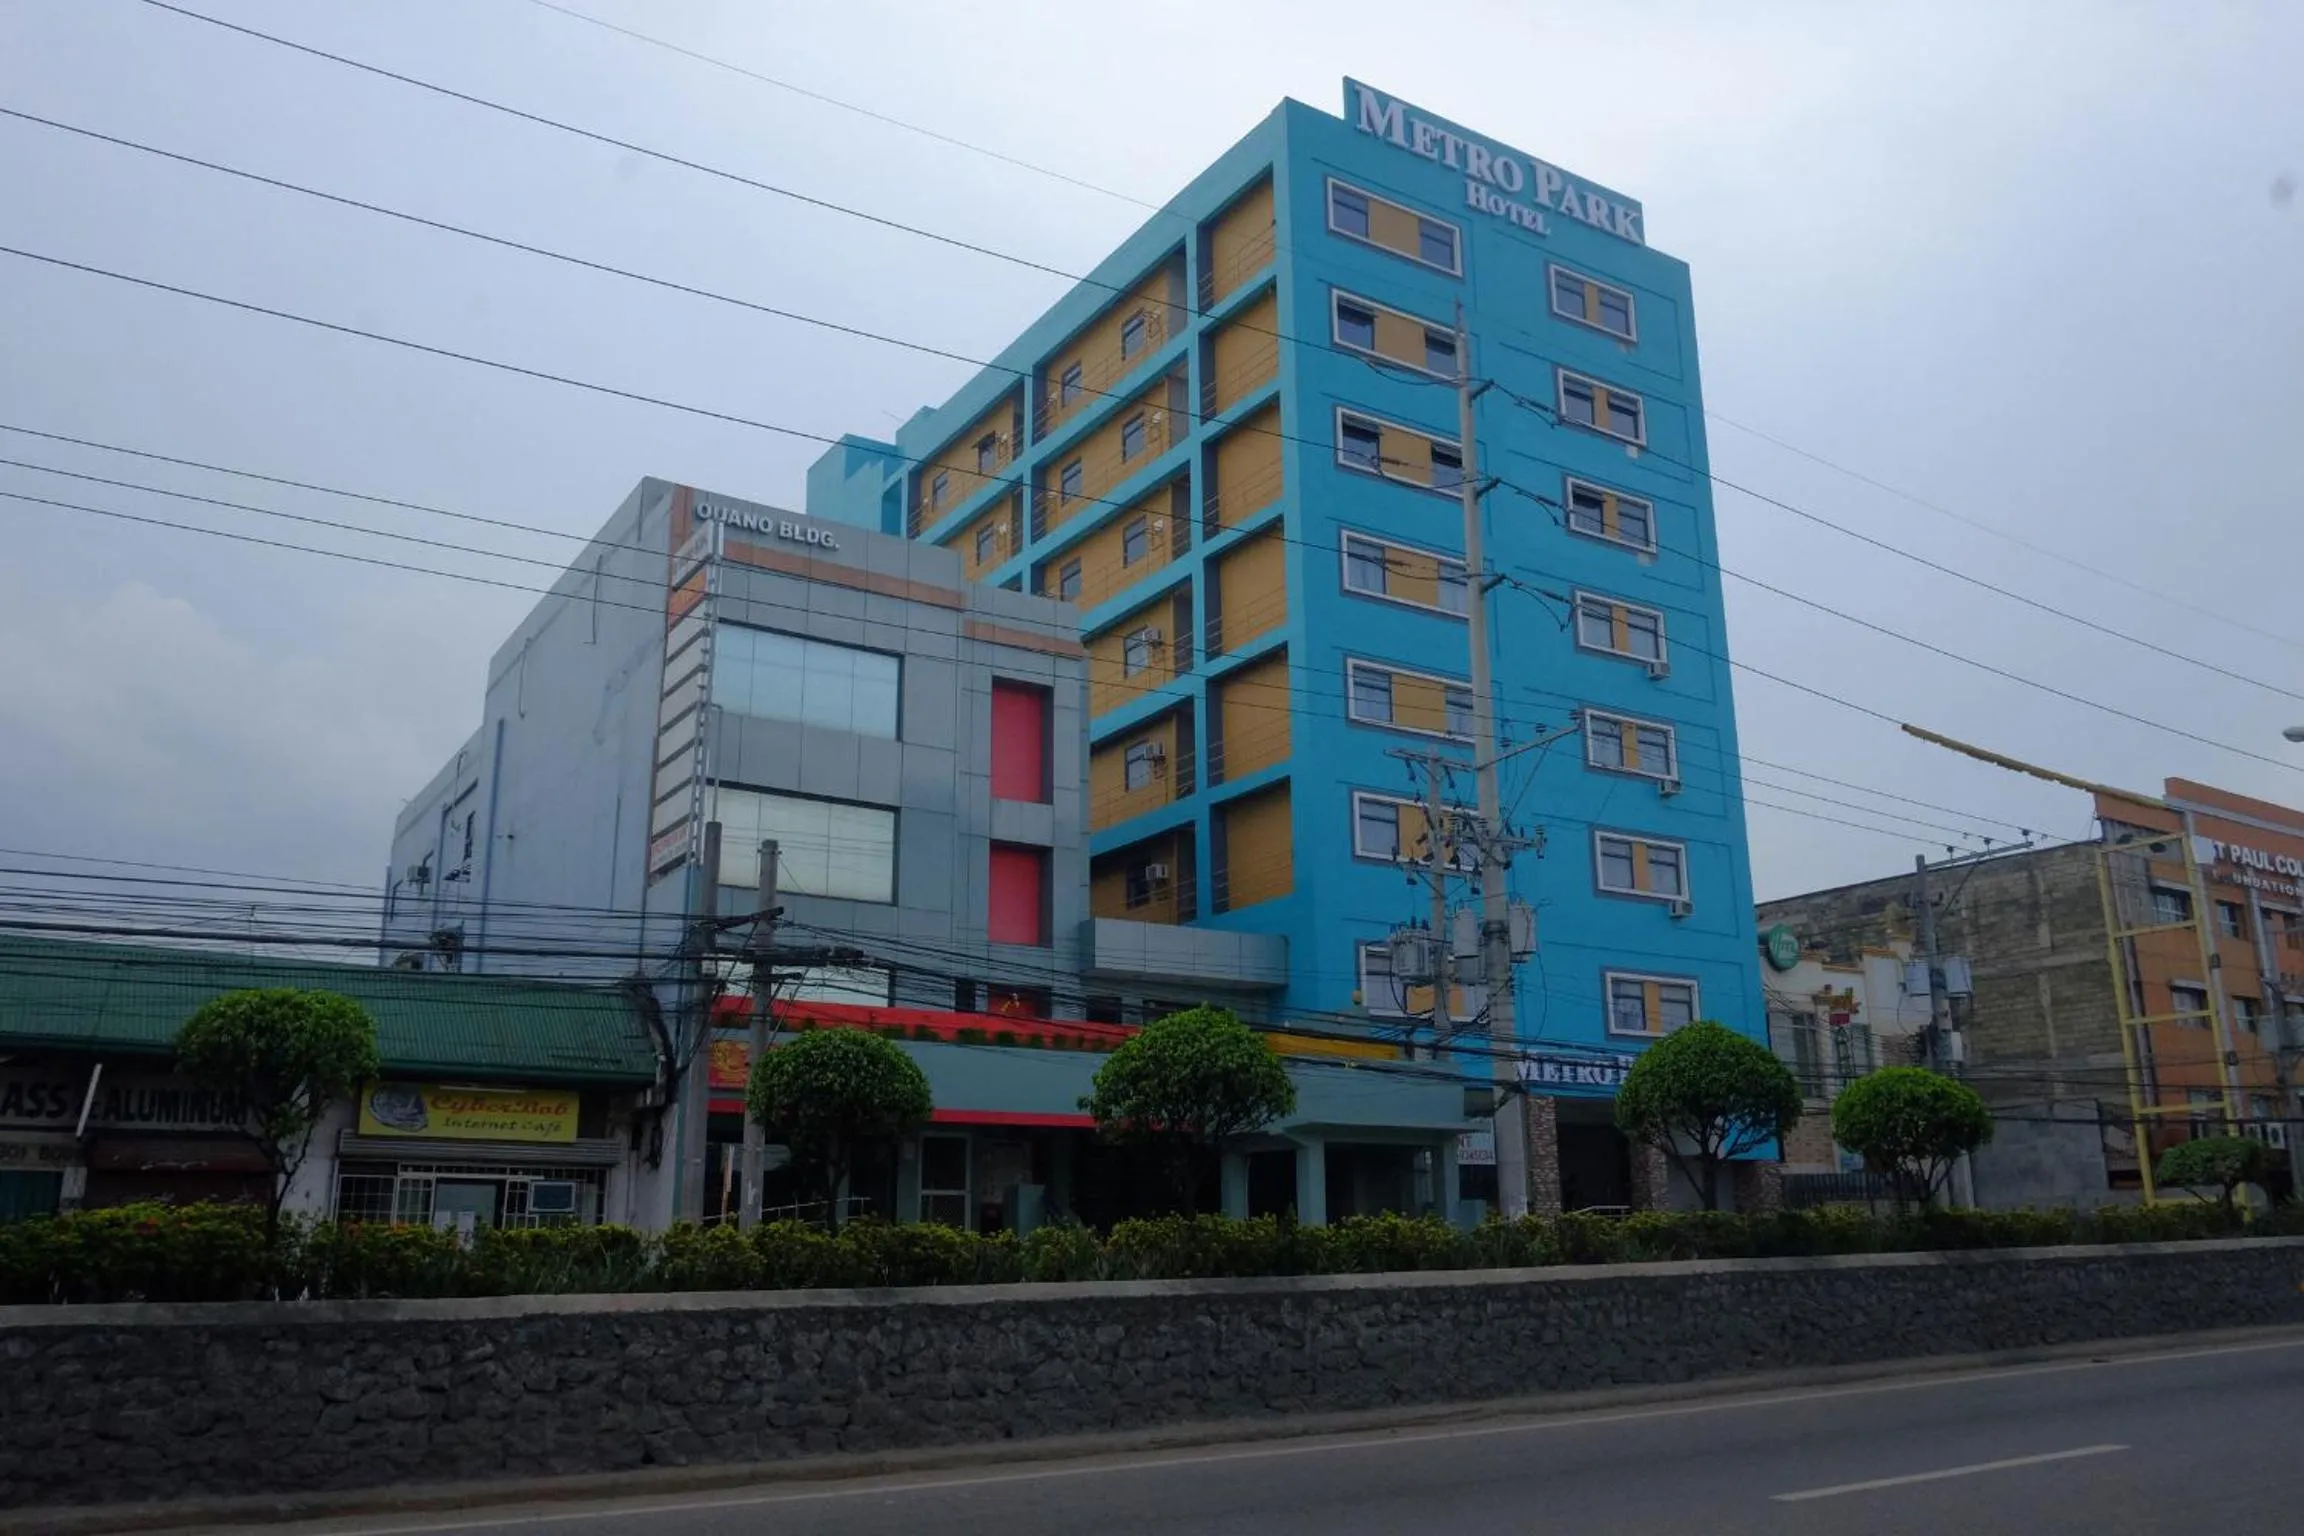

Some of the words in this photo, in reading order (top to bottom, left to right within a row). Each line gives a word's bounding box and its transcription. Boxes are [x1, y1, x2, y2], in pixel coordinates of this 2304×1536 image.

[1354, 84, 1524, 194] METRO
[1531, 160, 1643, 246] PARK
[1465, 179, 1551, 237] HOTEL
[779, 520, 840, 550] BLDG.
[2229, 844, 2274, 871] PAUL
[102, 1088, 247, 1125] ALUMINUM
